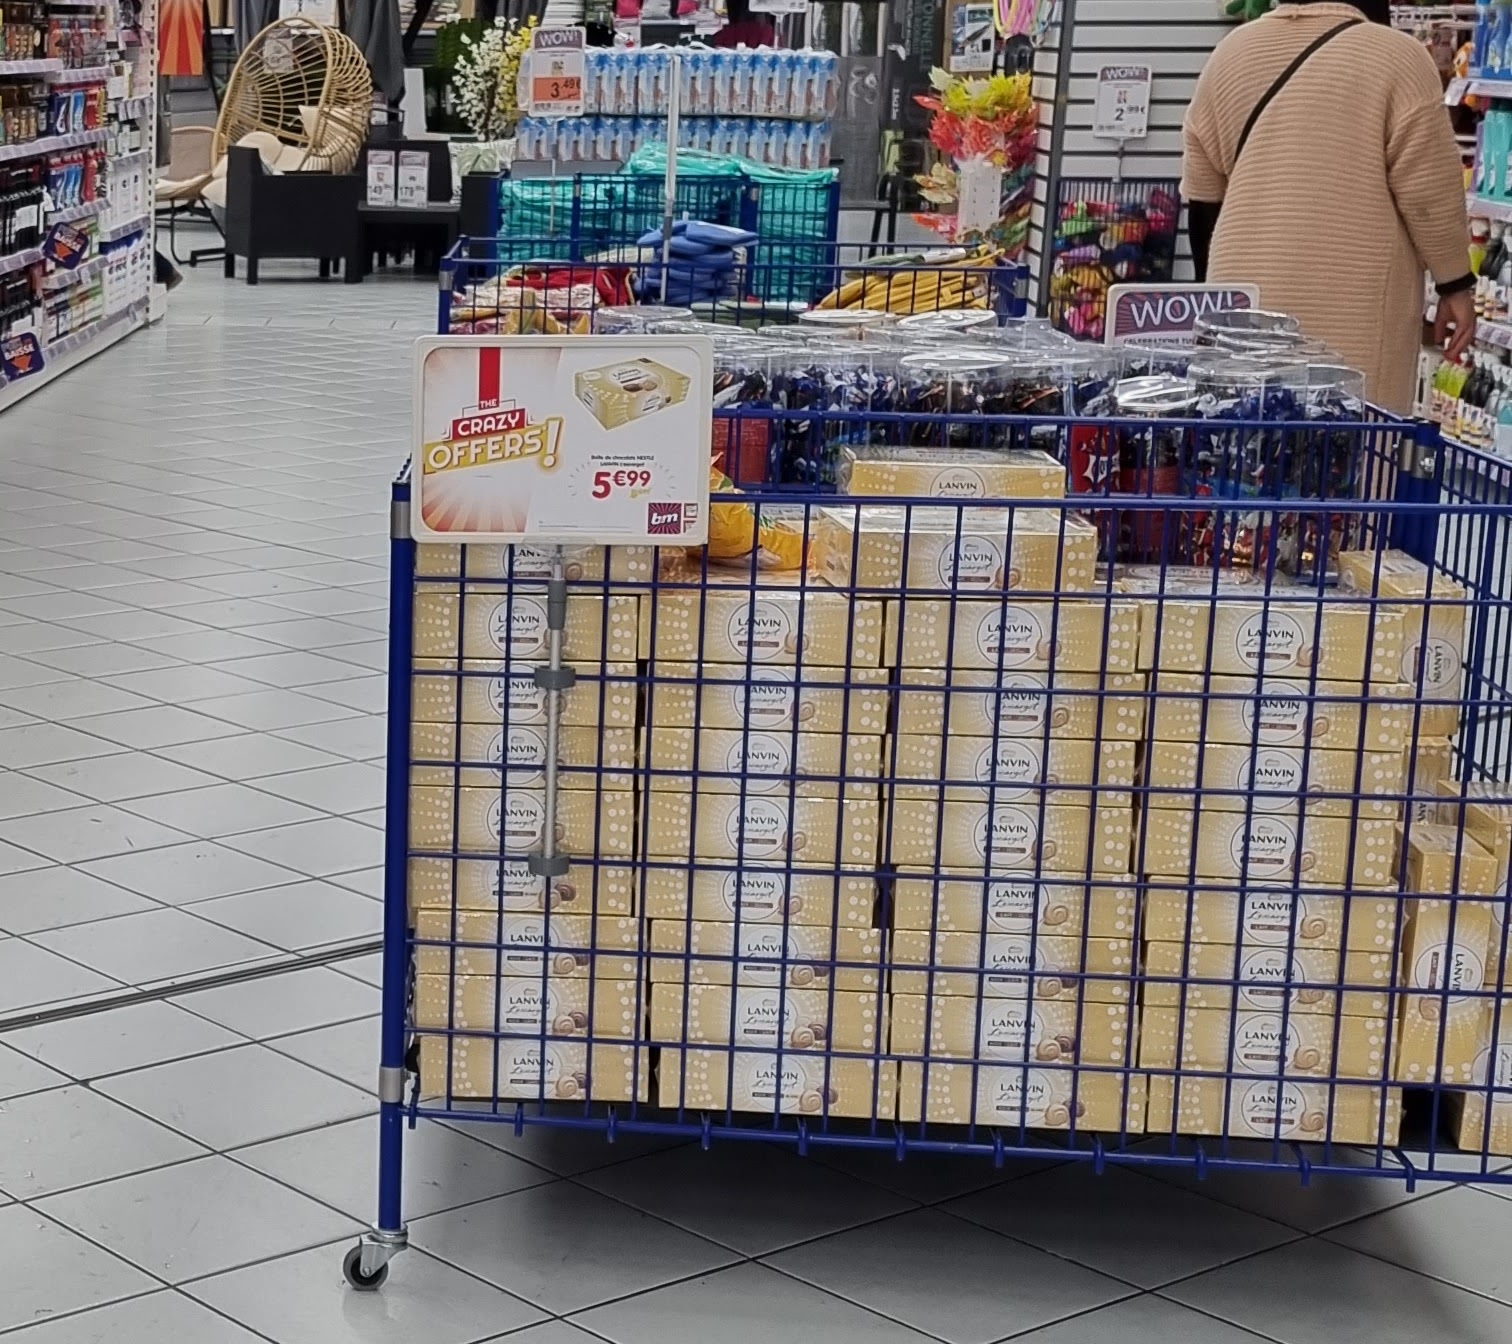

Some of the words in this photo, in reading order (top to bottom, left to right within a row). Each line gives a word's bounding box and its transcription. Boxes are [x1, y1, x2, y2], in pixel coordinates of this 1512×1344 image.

[540, 30, 578, 47] WOW!
[1131, 292, 1233, 329] WOW!
[479, 400, 498, 409] THE
[457, 412, 520, 437] CRAZY
[428, 418, 561, 469] OFFERS!
[592, 470, 652, 500] 5€99
[939, 482, 977, 490] LANVIN
[1433, 645, 1443, 684] LANVIN
[750, 686, 786, 695] ANVIN
[1002, 693, 1041, 702] ANVIN
[1260, 700, 1299, 710] ANVIN
[1256, 768, 1294, 778] ANVIN
[748, 943, 789, 953] LANVI
[993, 955, 1030, 964] LANVI
[748, 1007, 790, 1016] LANVN
[513, 1057, 555, 1067] LANVN
